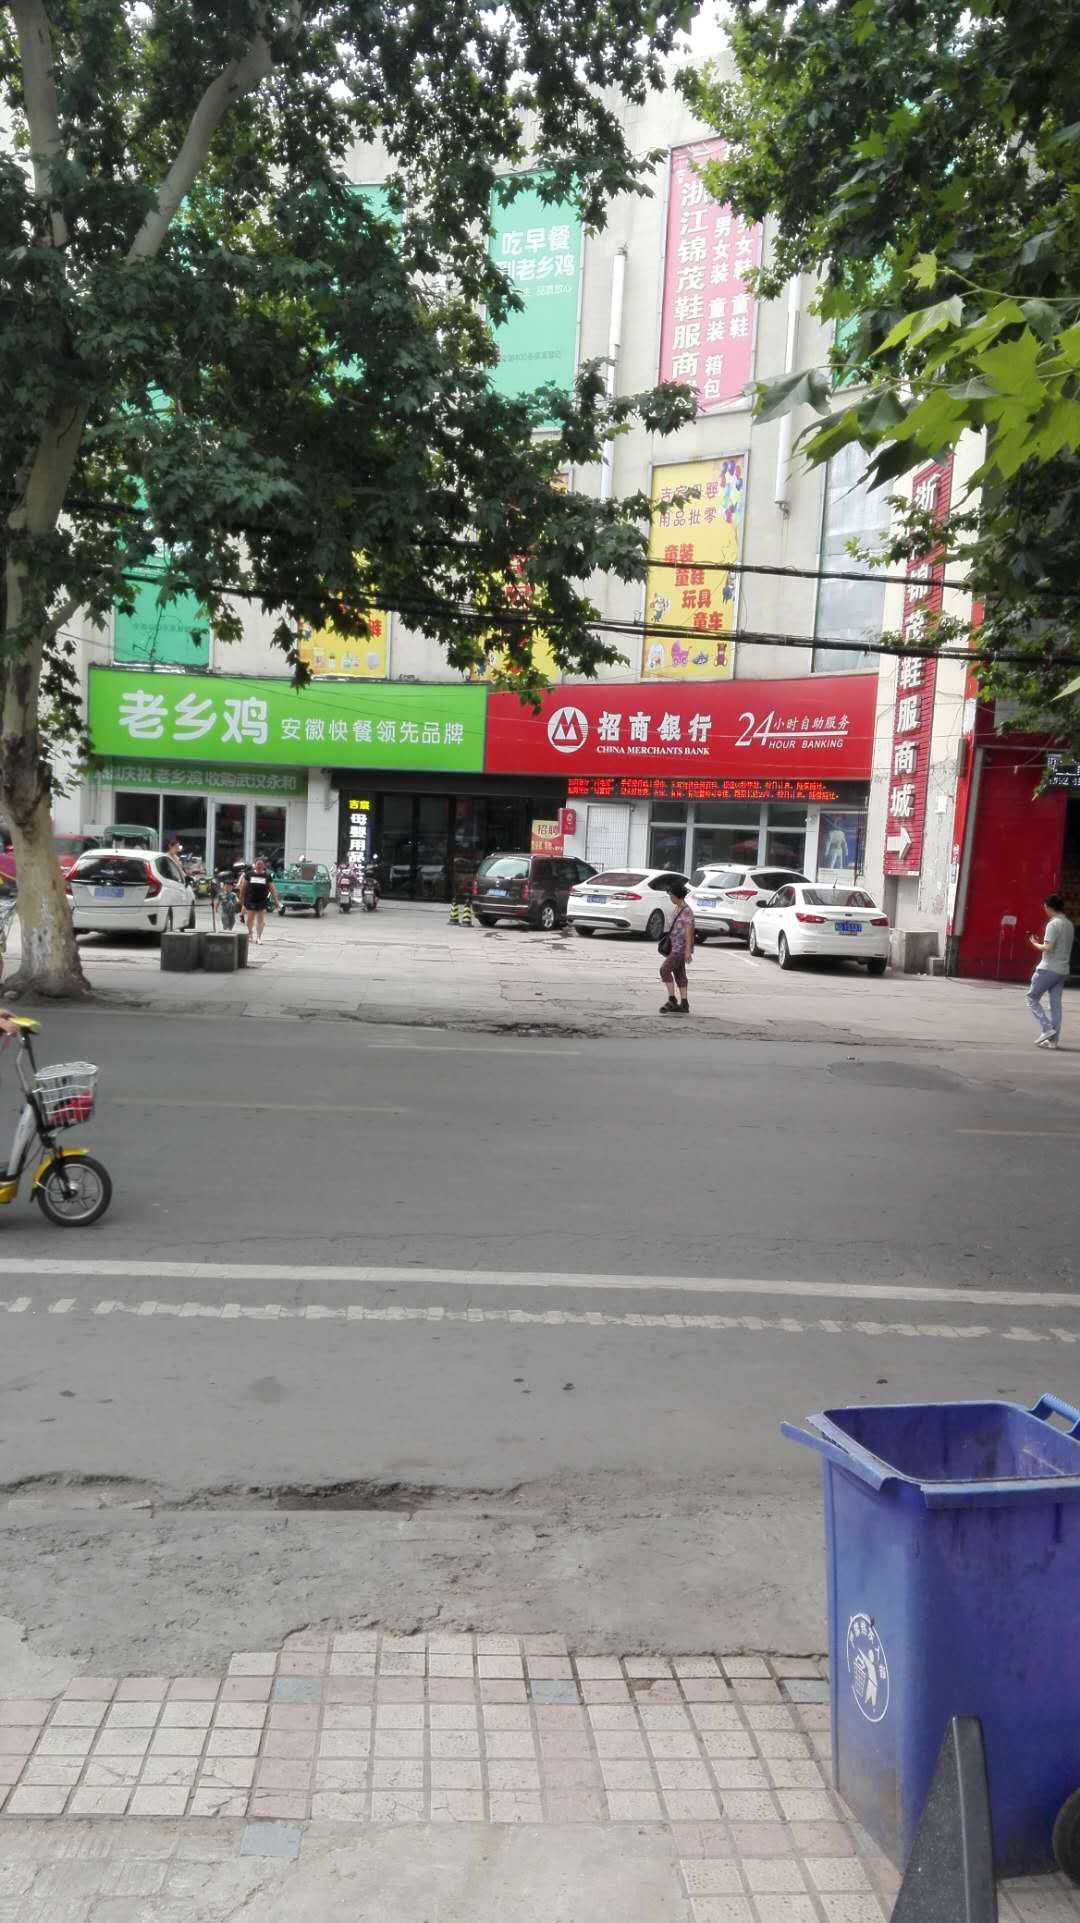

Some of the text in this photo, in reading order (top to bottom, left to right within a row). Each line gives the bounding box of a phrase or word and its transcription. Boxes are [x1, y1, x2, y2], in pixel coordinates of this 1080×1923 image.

[501, 224, 572, 256] 吃早餐
[495, 253, 575, 281] 到老乡鸡
[671, 181, 709, 386] 浙江锦茂鞋服商
[703, 214, 732, 398] 男女装 童装 箱包
[729, 292, 750, 338] 童鞋
[660, 507, 717, 527] 用品批零
[664, 544, 695, 563] 童装
[682, 589, 711, 609] 玩具
[693, 611, 723, 631] 童车
[889, 473, 941, 818] 浙锦茂鞋服商城
[118, 689, 466, 745] 老乡鸡 安徽快餐领先品牌
[596, 710, 713, 743] 招商银行
[734, 710, 851, 747] 24 小时自助服务
[596, 745, 711, 756] CHINA MERCHANTS BANK
[768, 738, 844, 750] HOUR BANKING
